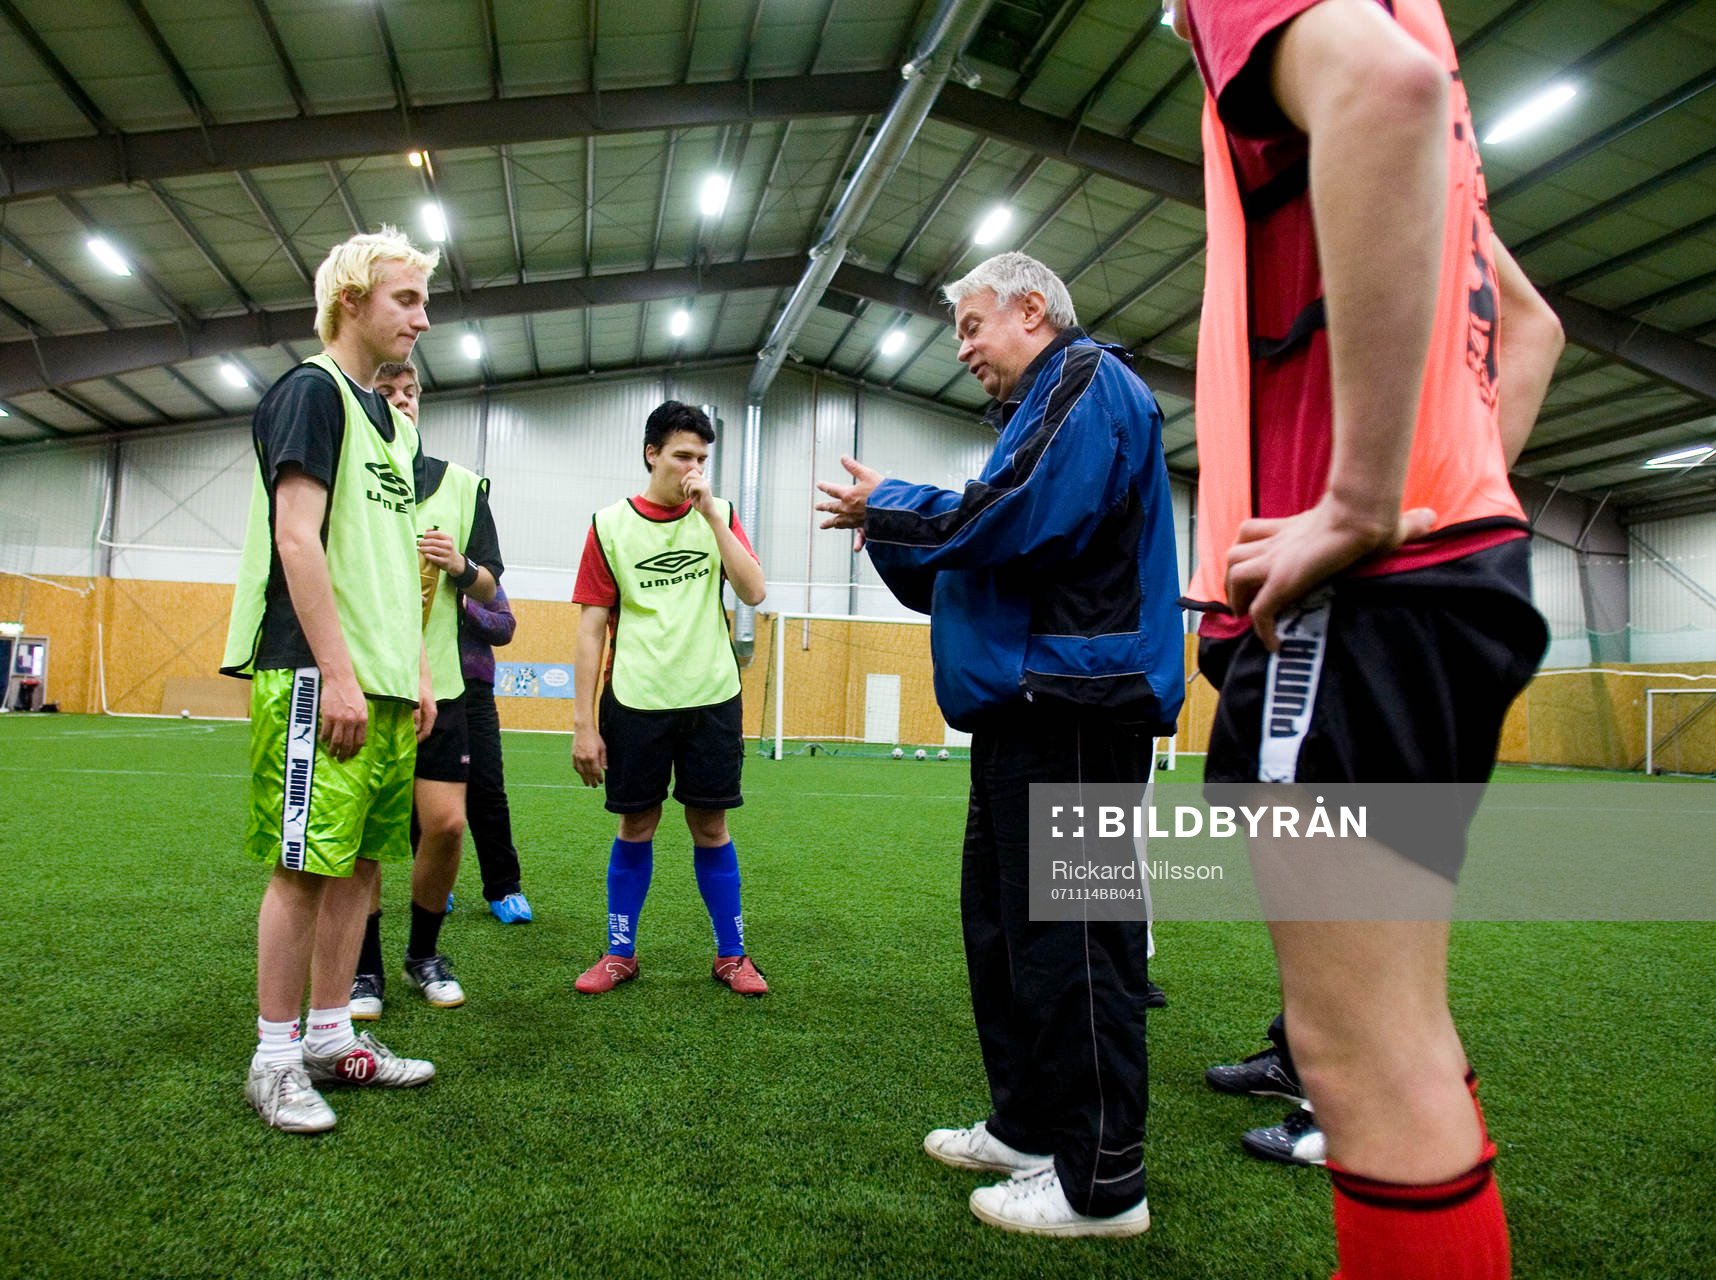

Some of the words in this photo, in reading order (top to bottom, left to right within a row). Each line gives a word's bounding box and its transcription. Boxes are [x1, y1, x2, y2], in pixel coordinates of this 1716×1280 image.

[639, 568, 710, 589] UMBRO
[295, 676, 315, 725] PUMA
[1270, 638, 1318, 738] PUMA
[289, 758, 309, 807] PUMA
[286, 841, 301, 869] PU
[344, 1056, 368, 1079] 90
